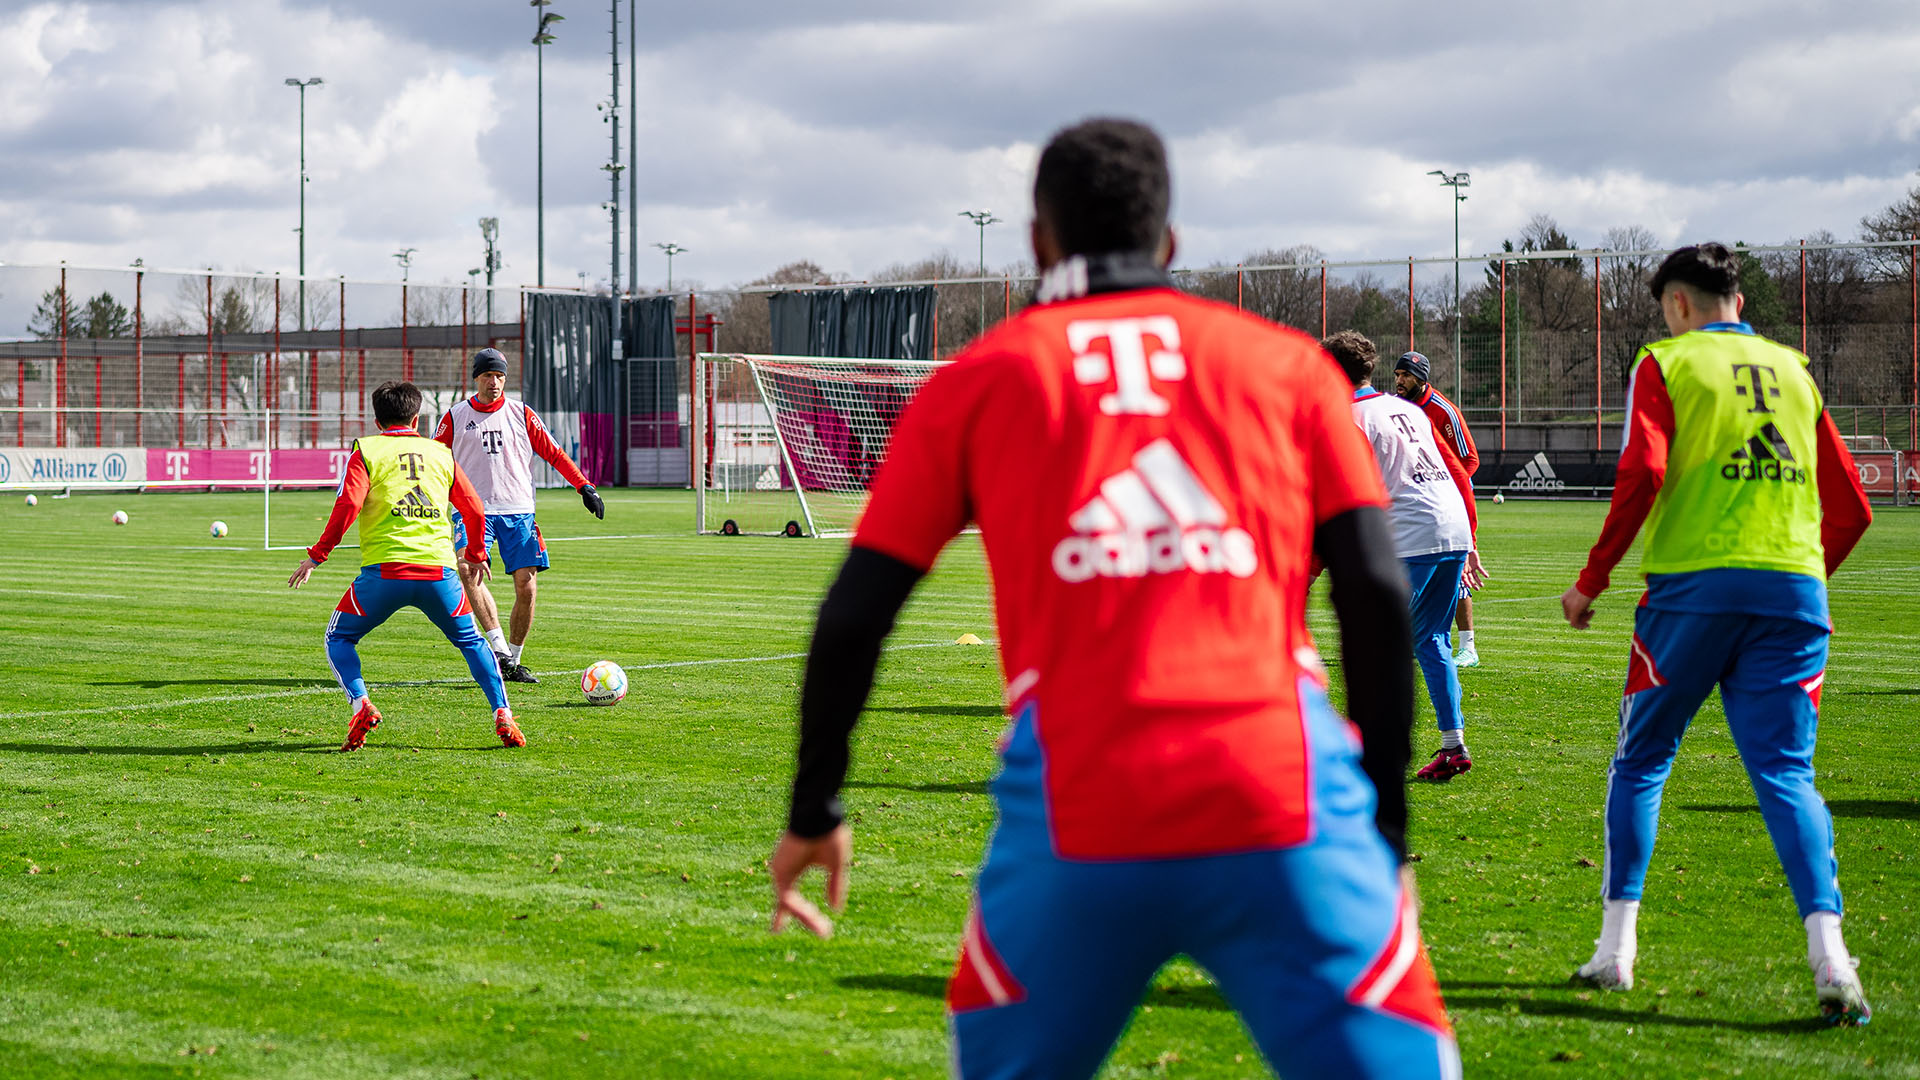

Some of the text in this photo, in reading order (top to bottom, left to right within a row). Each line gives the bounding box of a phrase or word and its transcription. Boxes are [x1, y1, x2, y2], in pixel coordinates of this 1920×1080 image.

[1732, 364, 1780, 413] T
[482, 430, 502, 454] T
[32, 458, 98, 479] Allianz
[165, 451, 189, 480] T
[398, 452, 425, 480] T
[1721, 459, 1806, 485] adidas
[1509, 477, 1565, 493] adidas
[391, 505, 440, 519] adidas
[1051, 524, 1258, 583] adidas
